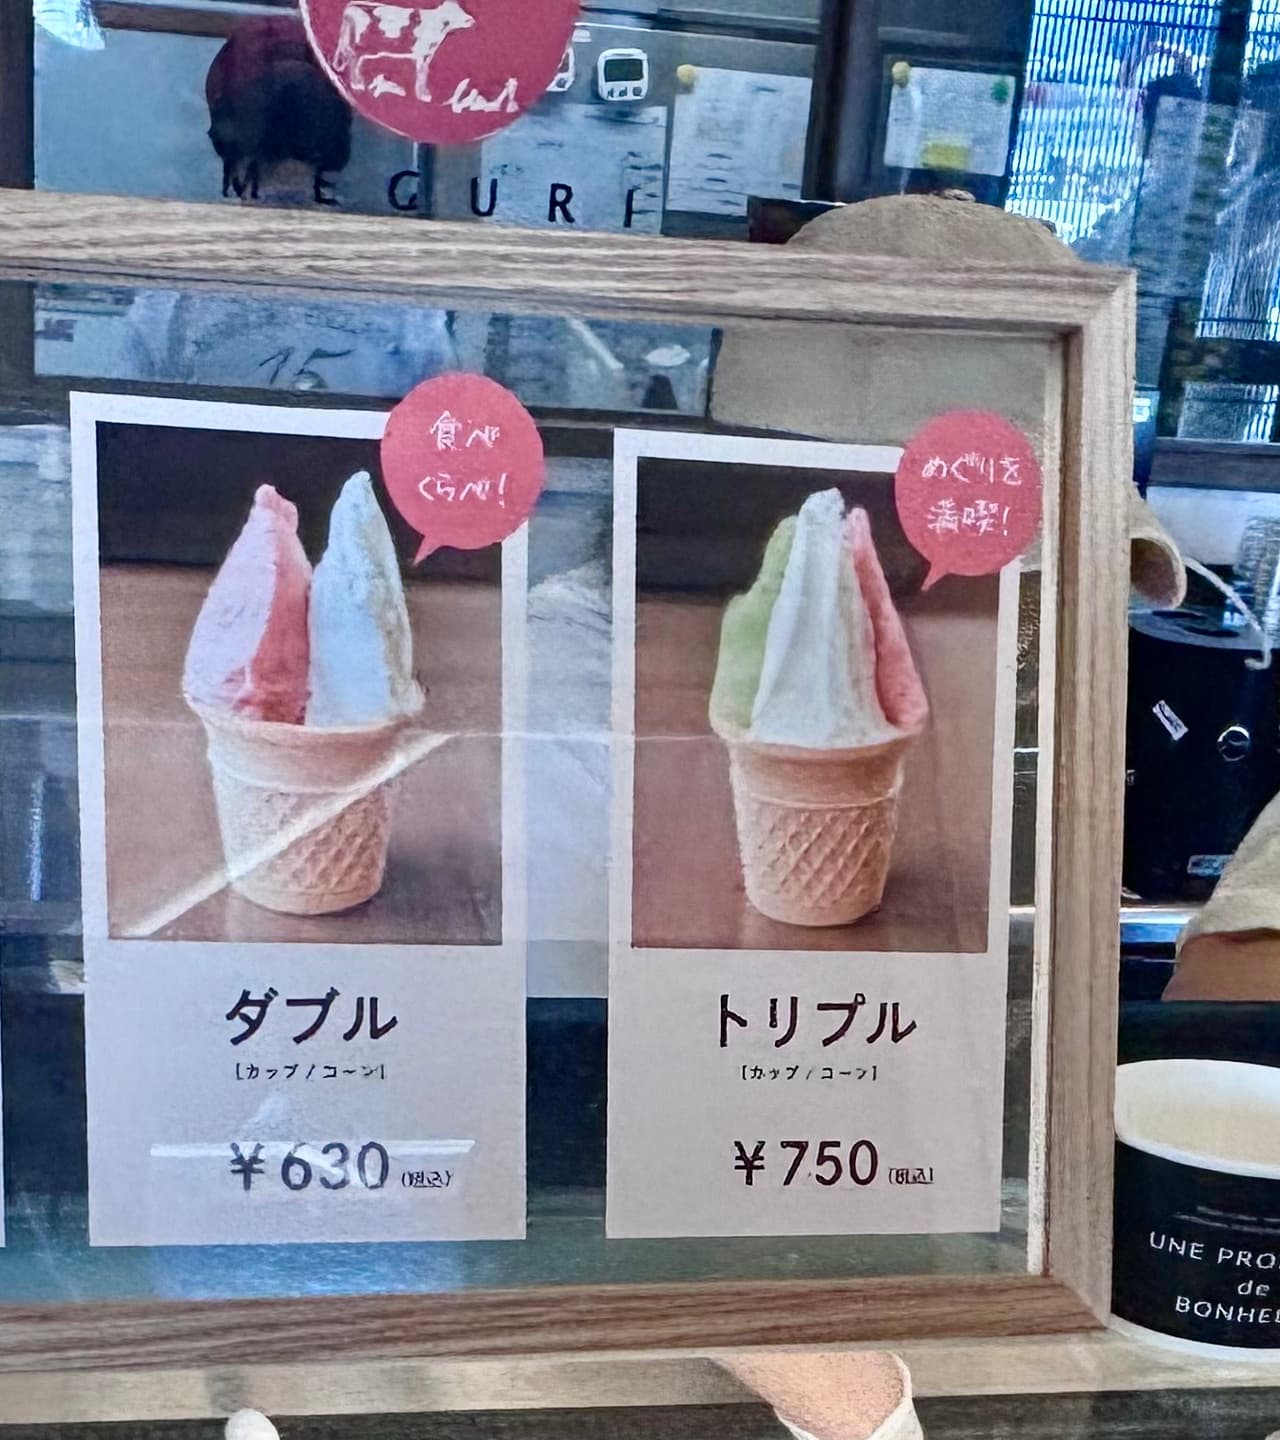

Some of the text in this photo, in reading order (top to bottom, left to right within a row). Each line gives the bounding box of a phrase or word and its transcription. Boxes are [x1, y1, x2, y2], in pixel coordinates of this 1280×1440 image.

[429, 409, 501, 452] 食べ
[921, 451, 1023, 486] めぐりを
[224, 986, 399, 1046] ダブル
[719, 992, 917, 1049] トリプル
[733, 1139, 879, 1187] ¥750
[1149, 1231, 1205, 1261] UNE
[1237, 1279, 1270, 1297] de
